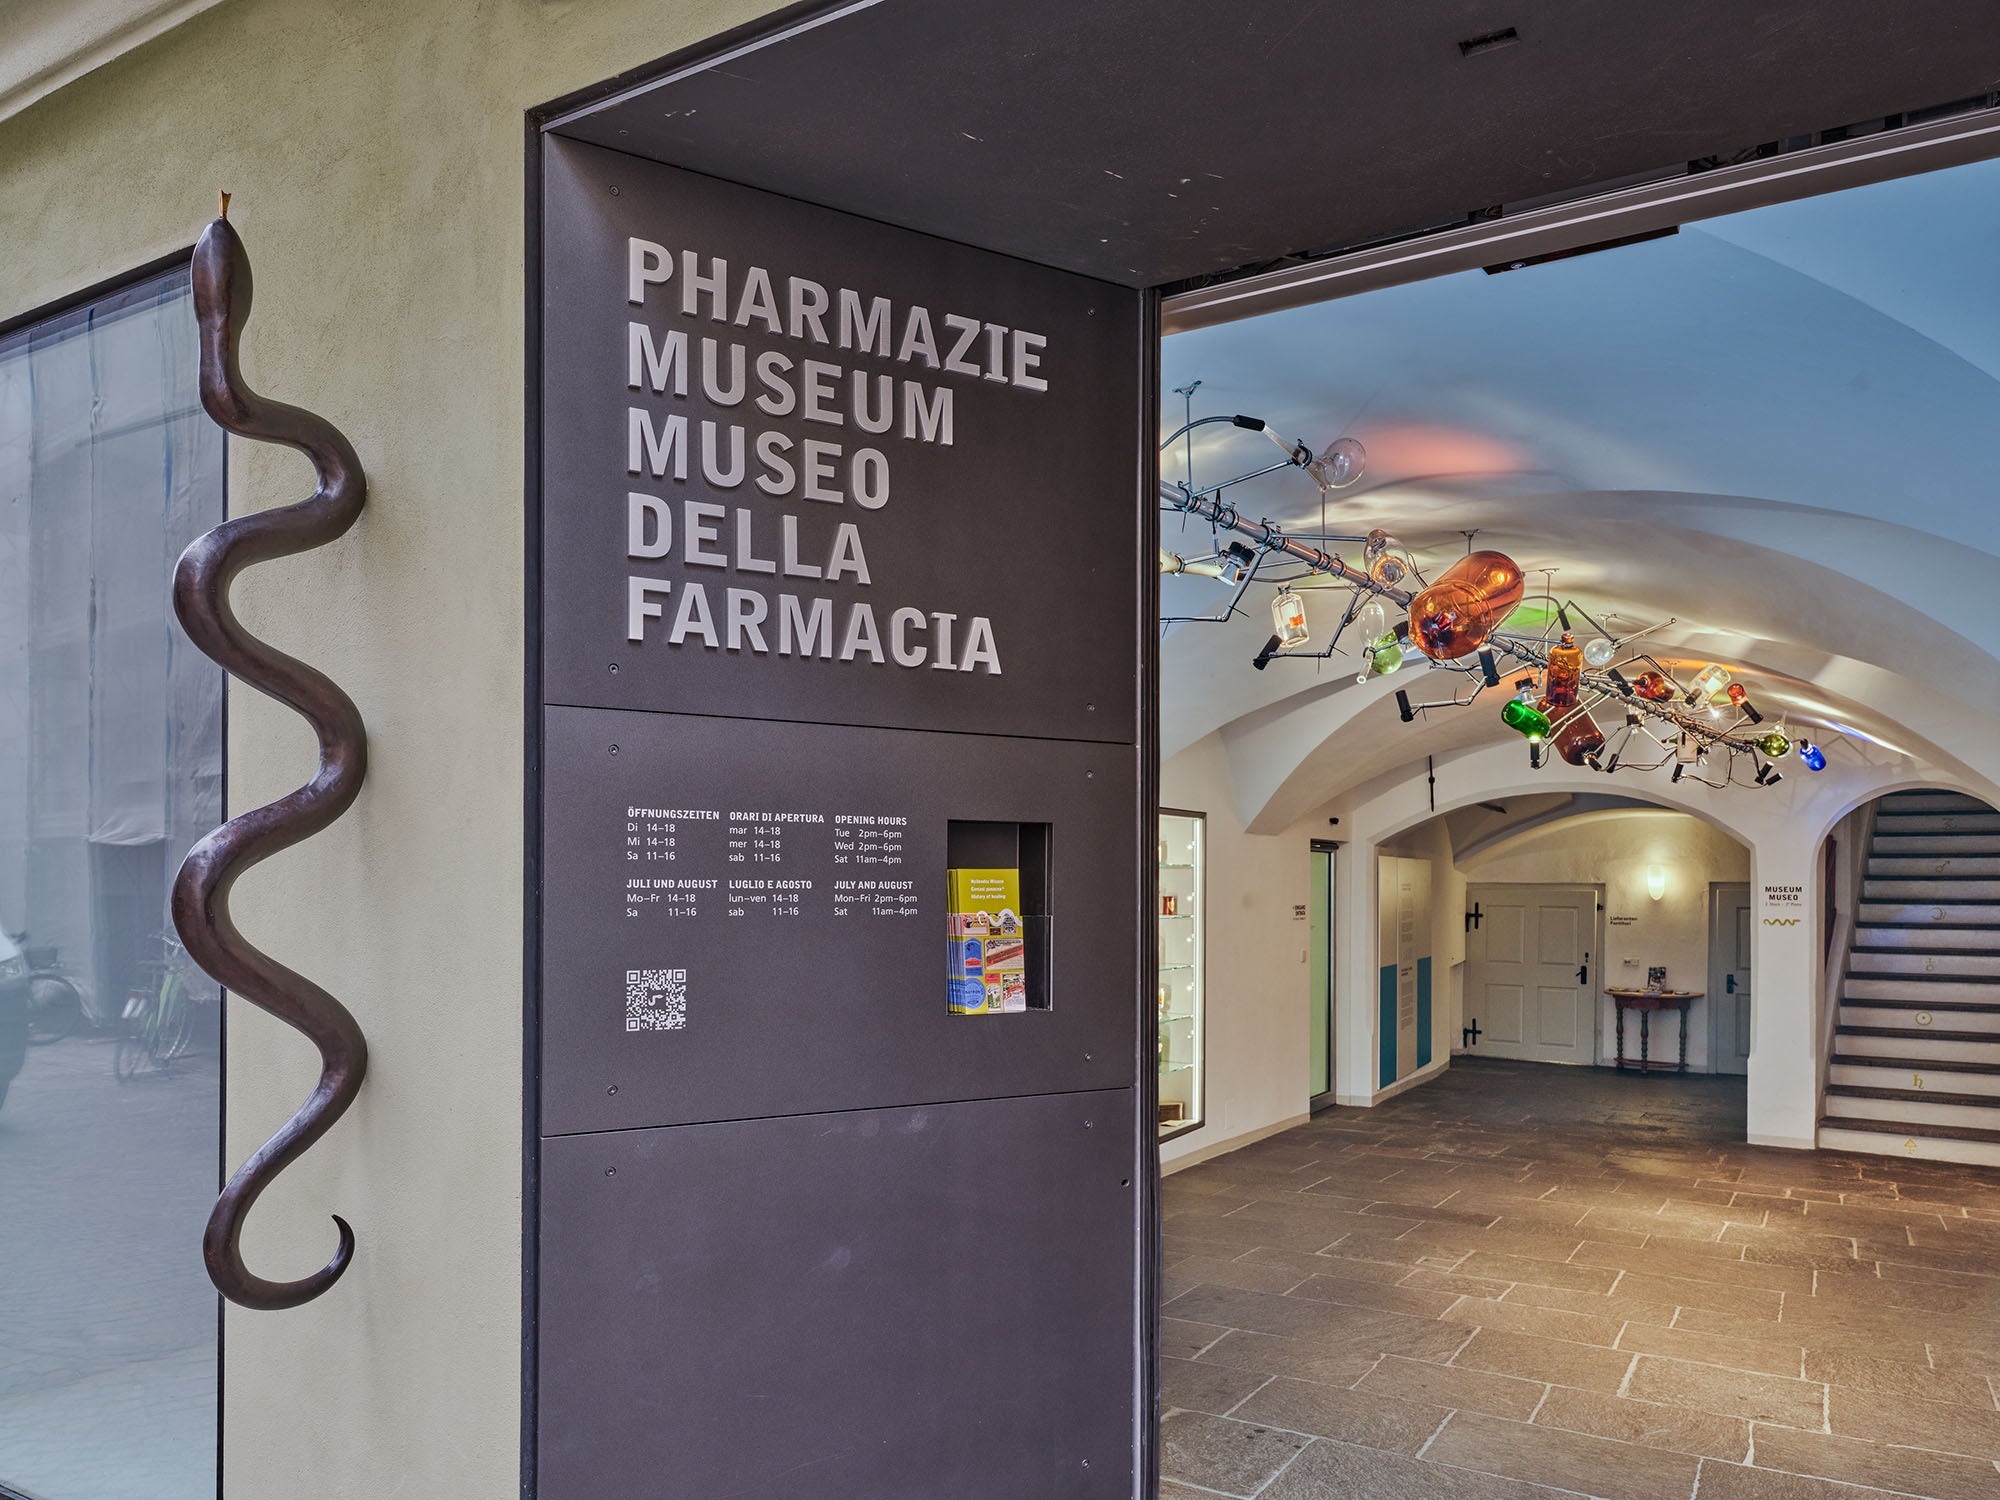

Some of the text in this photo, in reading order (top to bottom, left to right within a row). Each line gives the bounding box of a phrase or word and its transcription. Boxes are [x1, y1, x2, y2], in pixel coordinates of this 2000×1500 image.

[628, 237, 1048, 392] PHARMAZIE
[628, 321, 954, 446] MUSEUM
[628, 407, 890, 511] MUSEO
[628, 492, 872, 585] DELLA
[628, 576, 1002, 675] FARMACIA
[628, 806, 719, 820] ÖFFNUNGSZEITEN
[730, 812, 824, 823] ORARI DI APERTURA
[835, 815, 907, 825] OPENING HOURS
[628, 823, 675, 832] Di 14–18
[754, 826, 780, 835] 14–18
[835, 828, 901, 839] Tue 2pm–6pm
[628, 837, 675, 846] Mi 14–18
[754, 840, 780, 849] 14–18
[835, 842, 901, 852] Wed 2pm–6pm
[627, 851, 675, 860] Sa 11–16
[729, 853, 780, 862] sab 11–16
[835, 855, 901, 865] Sat 11am–4pm
[626, 879, 718, 888] JULI UND AUGUST
[729, 880, 812, 889] LUGLIO E AGOSTO
[834, 881, 913, 889] JULY AND AUGUST
[627, 894, 695, 902] Mo–Fr 14–18
[729, 894, 798, 902] lun–ven 14–18
[835, 894, 917, 904] Mon–Fri 2pm–6pm
[627, 908, 696, 917] Sa 11–16
[729, 907, 799, 916] sab 11–16
[834, 907, 917, 916] Sat 11am–4pm
